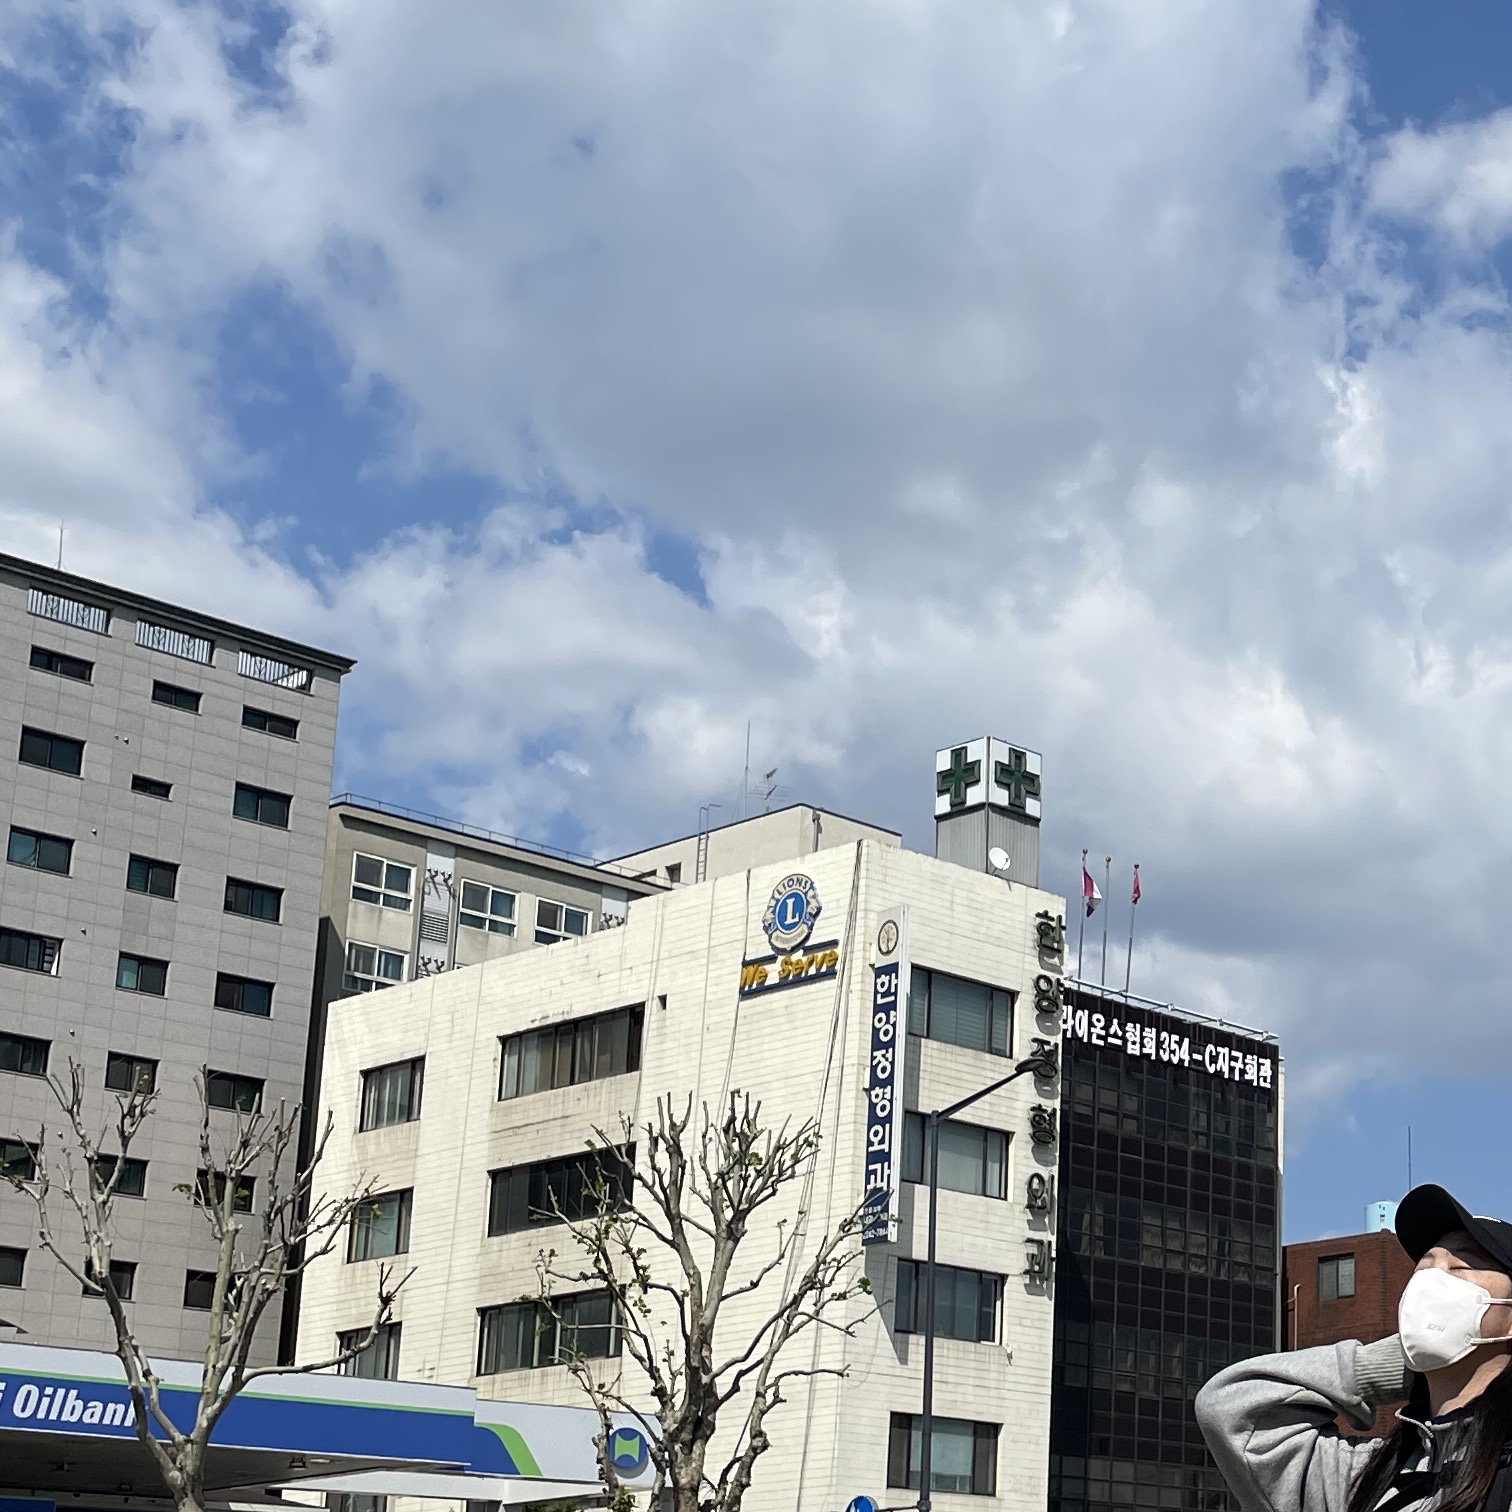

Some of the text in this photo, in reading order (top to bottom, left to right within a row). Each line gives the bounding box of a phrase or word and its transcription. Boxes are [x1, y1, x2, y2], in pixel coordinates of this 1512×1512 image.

[776, 876, 811, 896] LIONS
[784, 897, 799, 925] L
[740, 950, 839, 988] We Serve
[866, 971, 898, 1191] 한양정형외과
[1023, 909, 1067, 1296] 한양정형외과
